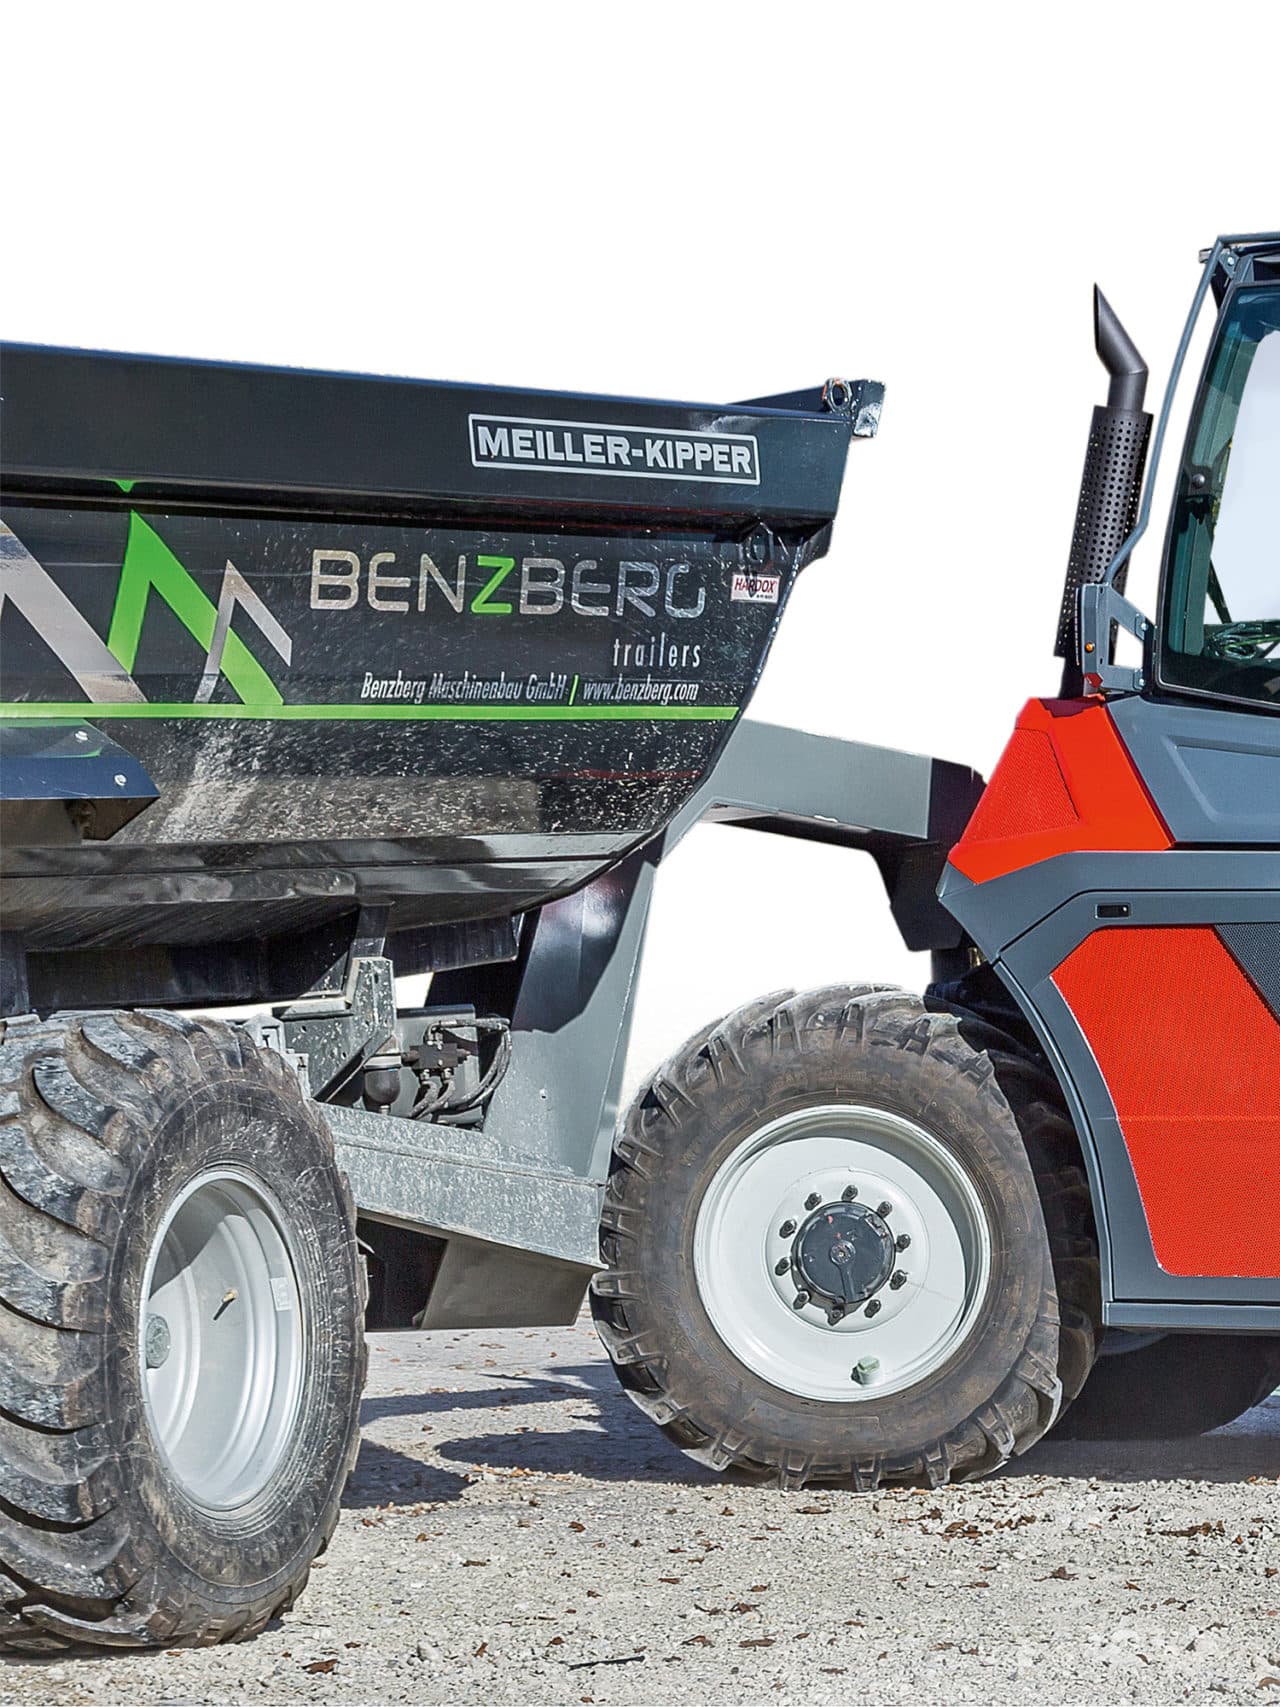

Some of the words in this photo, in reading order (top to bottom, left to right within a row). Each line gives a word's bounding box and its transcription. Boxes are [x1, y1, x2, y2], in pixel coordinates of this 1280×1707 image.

[476, 425, 752, 474] MEILLER-KIPPER
[309, 548, 706, 618] BENZBERG
[734, 577, 777, 593] HARDOX
[613, 631, 701, 668] trailers
[361, 669, 426, 704] Benzberg
[429, 670, 523, 699] Maschinenbau
[525, 671, 568, 701] GmbH
[583, 673, 699, 706] www.benzberg.com
